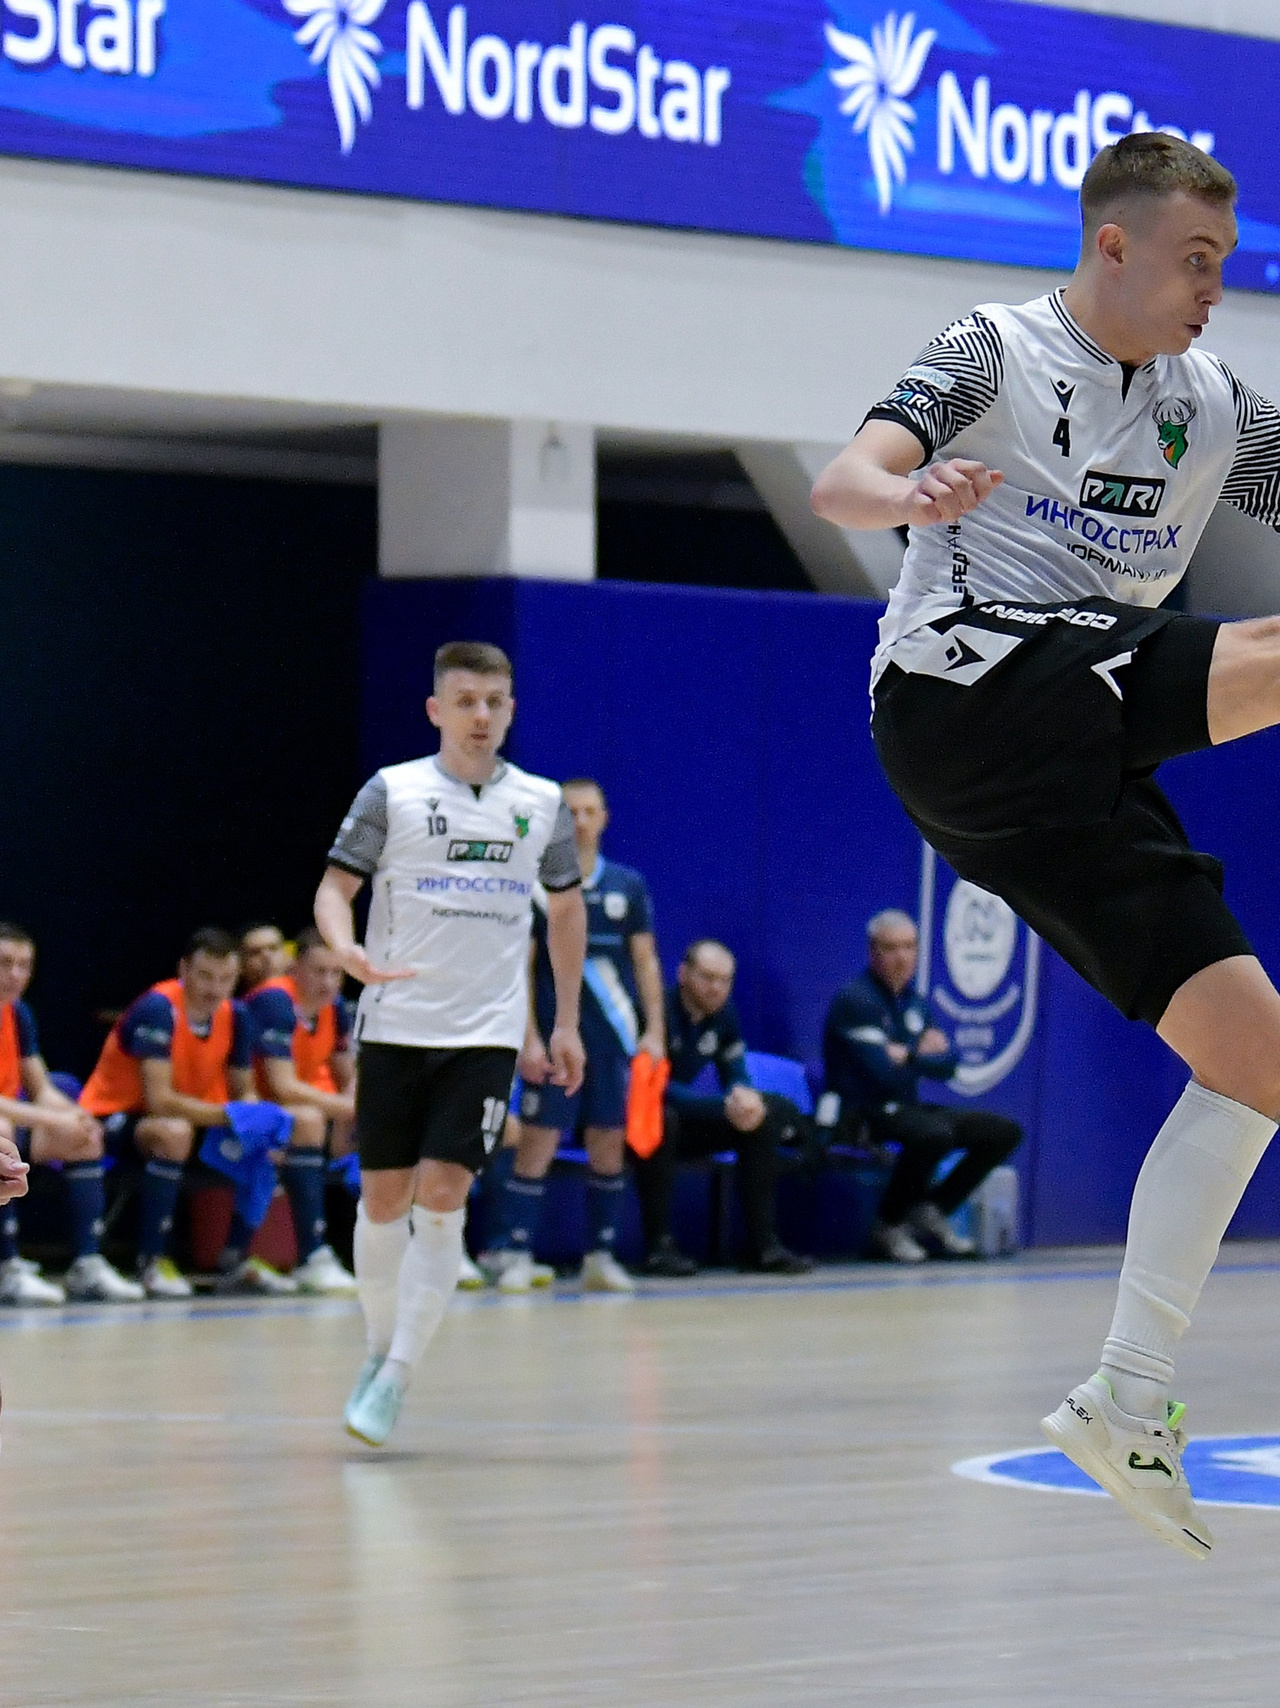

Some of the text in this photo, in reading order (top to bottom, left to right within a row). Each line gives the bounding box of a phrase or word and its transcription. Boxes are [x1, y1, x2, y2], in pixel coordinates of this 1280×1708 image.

[406, 1, 730, 146] NordStar
[938, 71, 1214, 190] NordS
[1052, 417, 1071, 457] 4
[1082, 478, 1162, 511] PARI
[1025, 495, 1183, 554] ИНГОССТРАХ
[428, 815, 448, 836] 10
